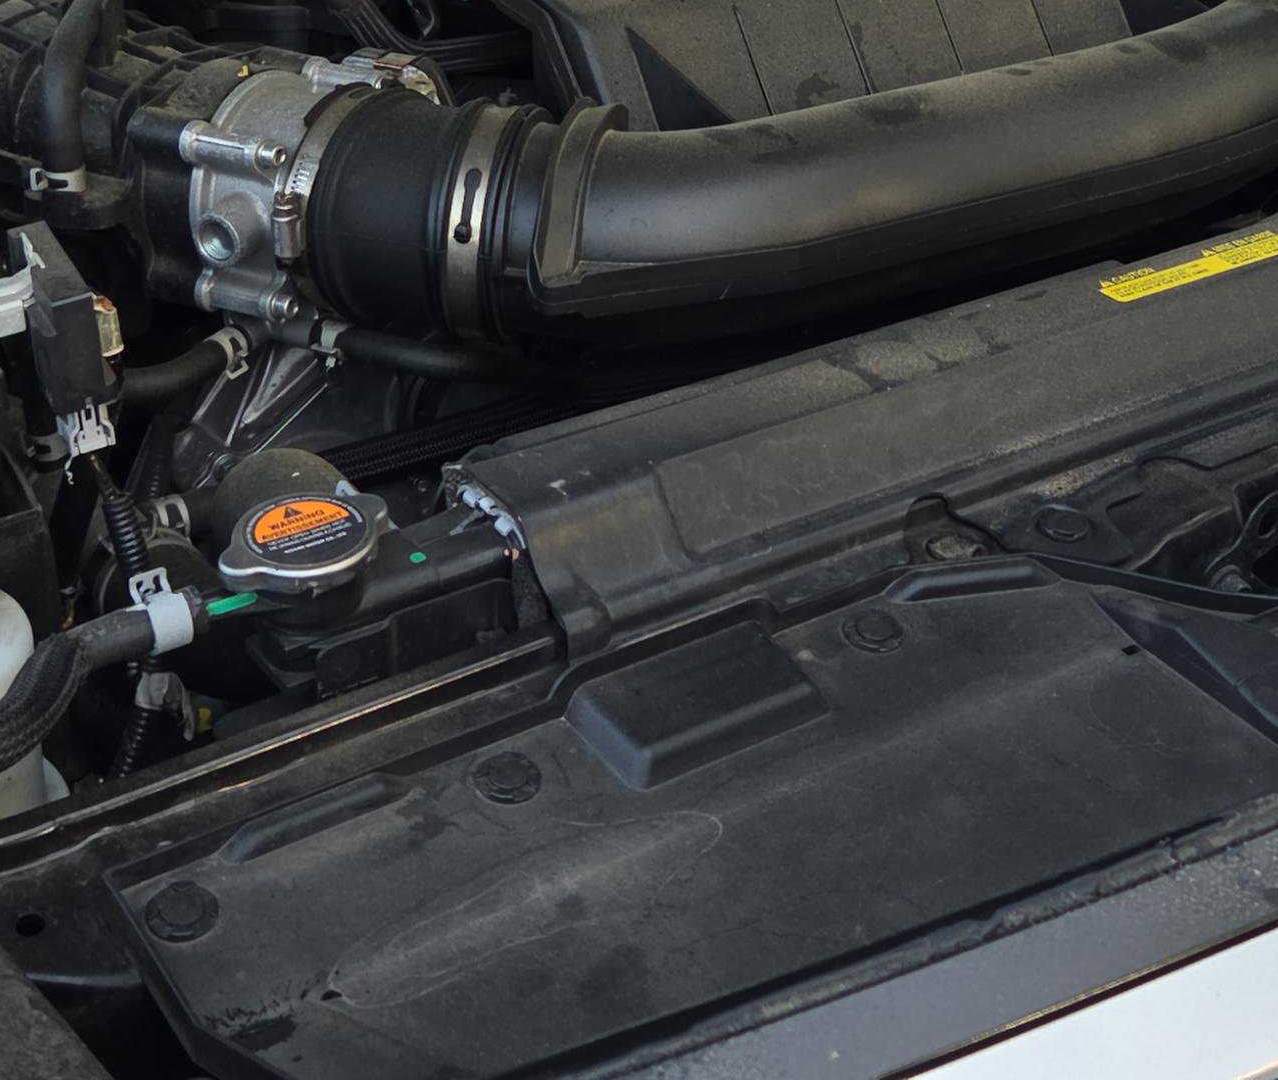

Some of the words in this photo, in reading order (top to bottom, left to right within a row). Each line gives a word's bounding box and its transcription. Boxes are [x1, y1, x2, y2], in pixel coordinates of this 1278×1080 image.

[1111, 267, 1155, 283] CAUTION
[261, 511, 343, 540] AVERTISSEMENT
[267, 509, 325, 531] WARNING
